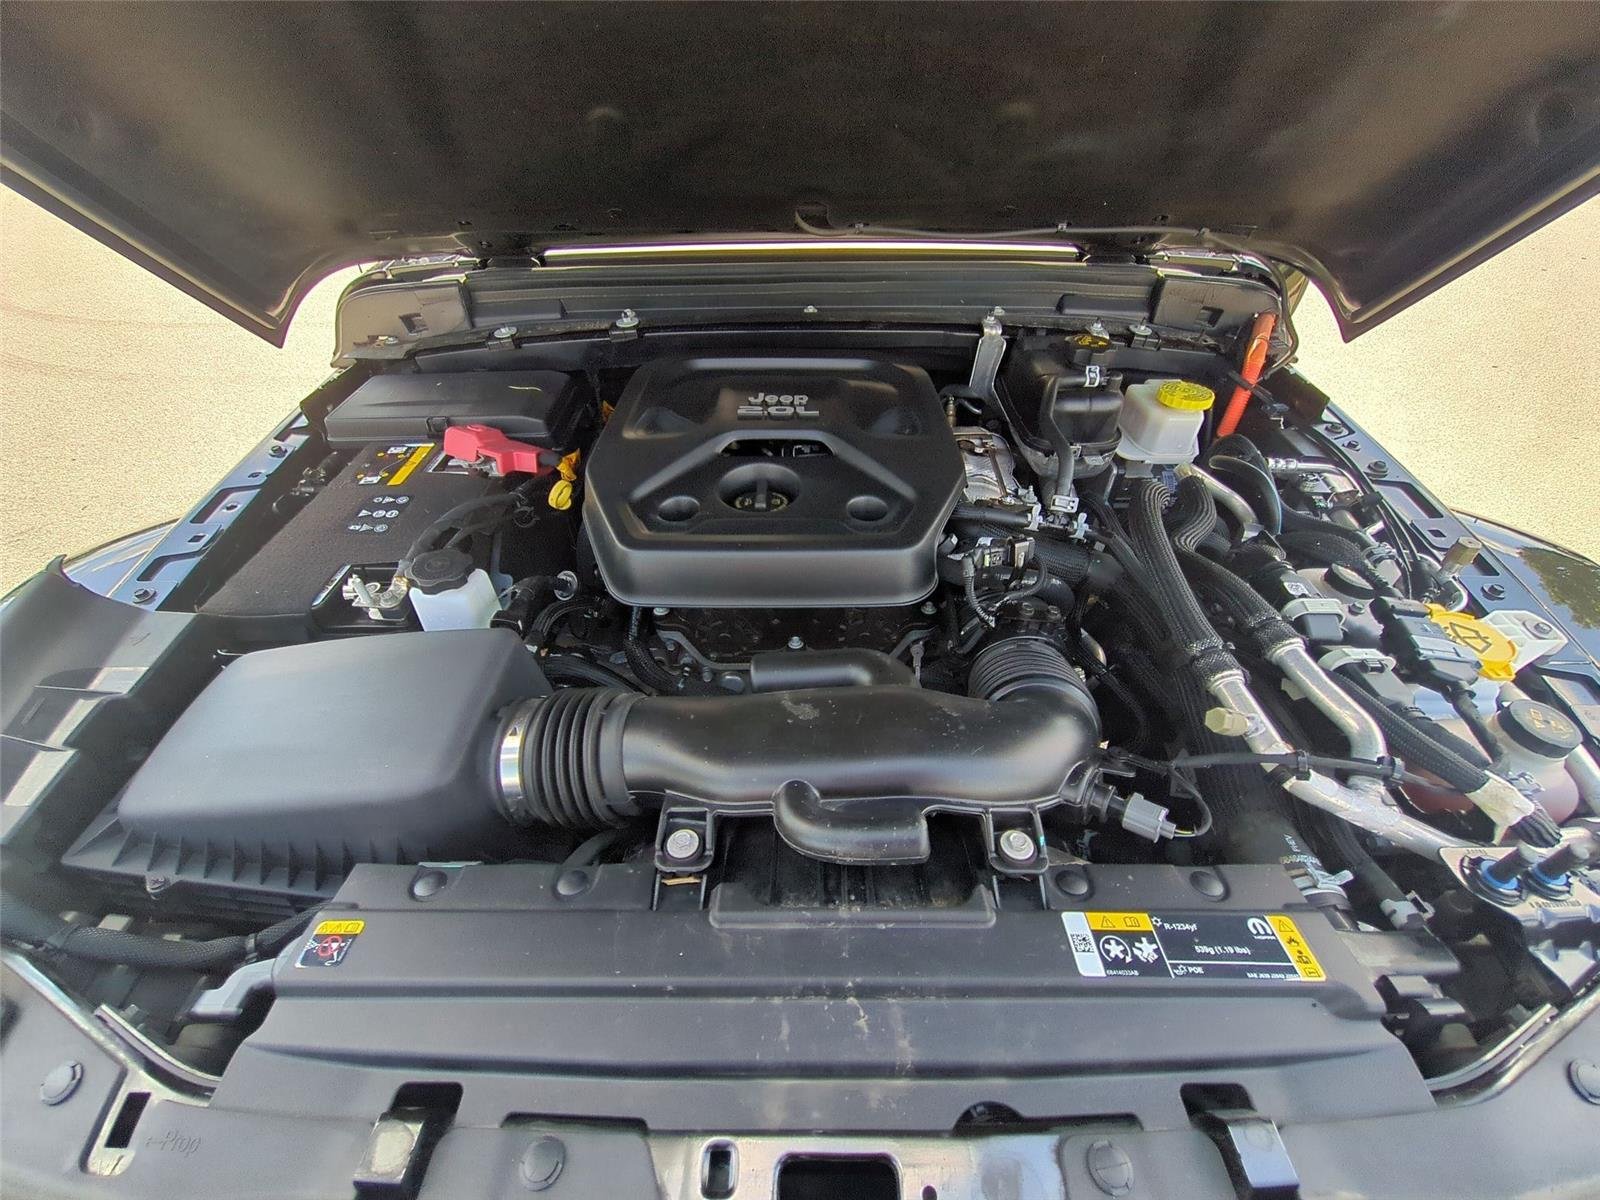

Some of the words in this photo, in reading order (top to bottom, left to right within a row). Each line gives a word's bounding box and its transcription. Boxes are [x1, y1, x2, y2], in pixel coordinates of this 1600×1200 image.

[748, 392, 809, 406] Jeep
[736, 405, 820, 418] 2.0L
[1188, 967, 1205, 975] POE
